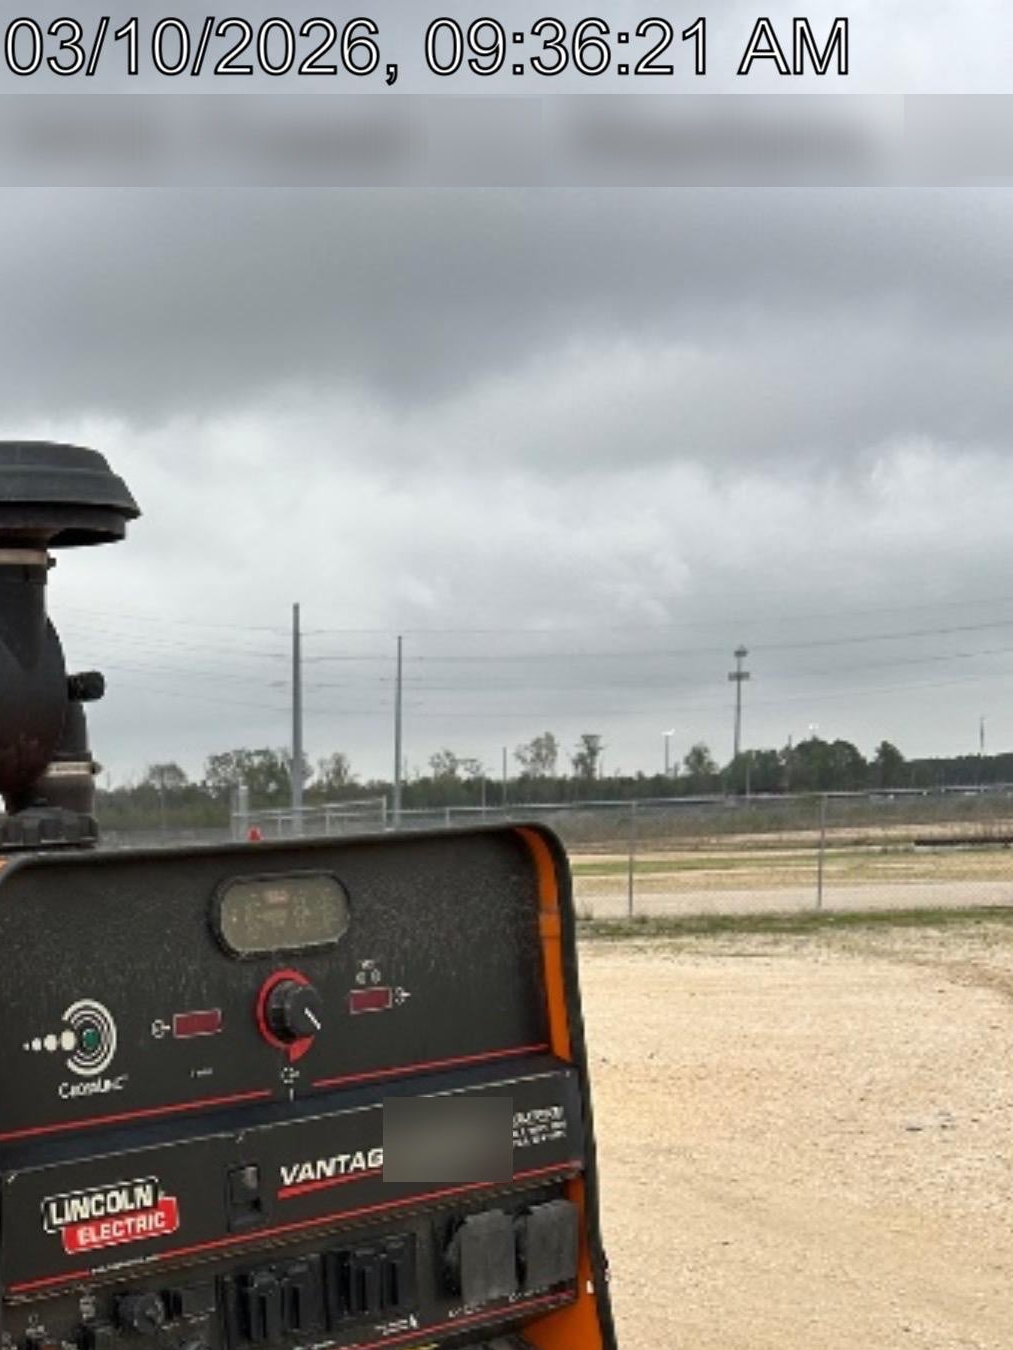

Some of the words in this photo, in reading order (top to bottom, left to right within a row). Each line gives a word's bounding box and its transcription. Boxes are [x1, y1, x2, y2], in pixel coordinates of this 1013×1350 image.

[279, 1147, 384, 1186] VANTAG
[49, 1184, 154, 1225] LINCOLN
[76, 1211, 166, 1245] ELECTRIC
